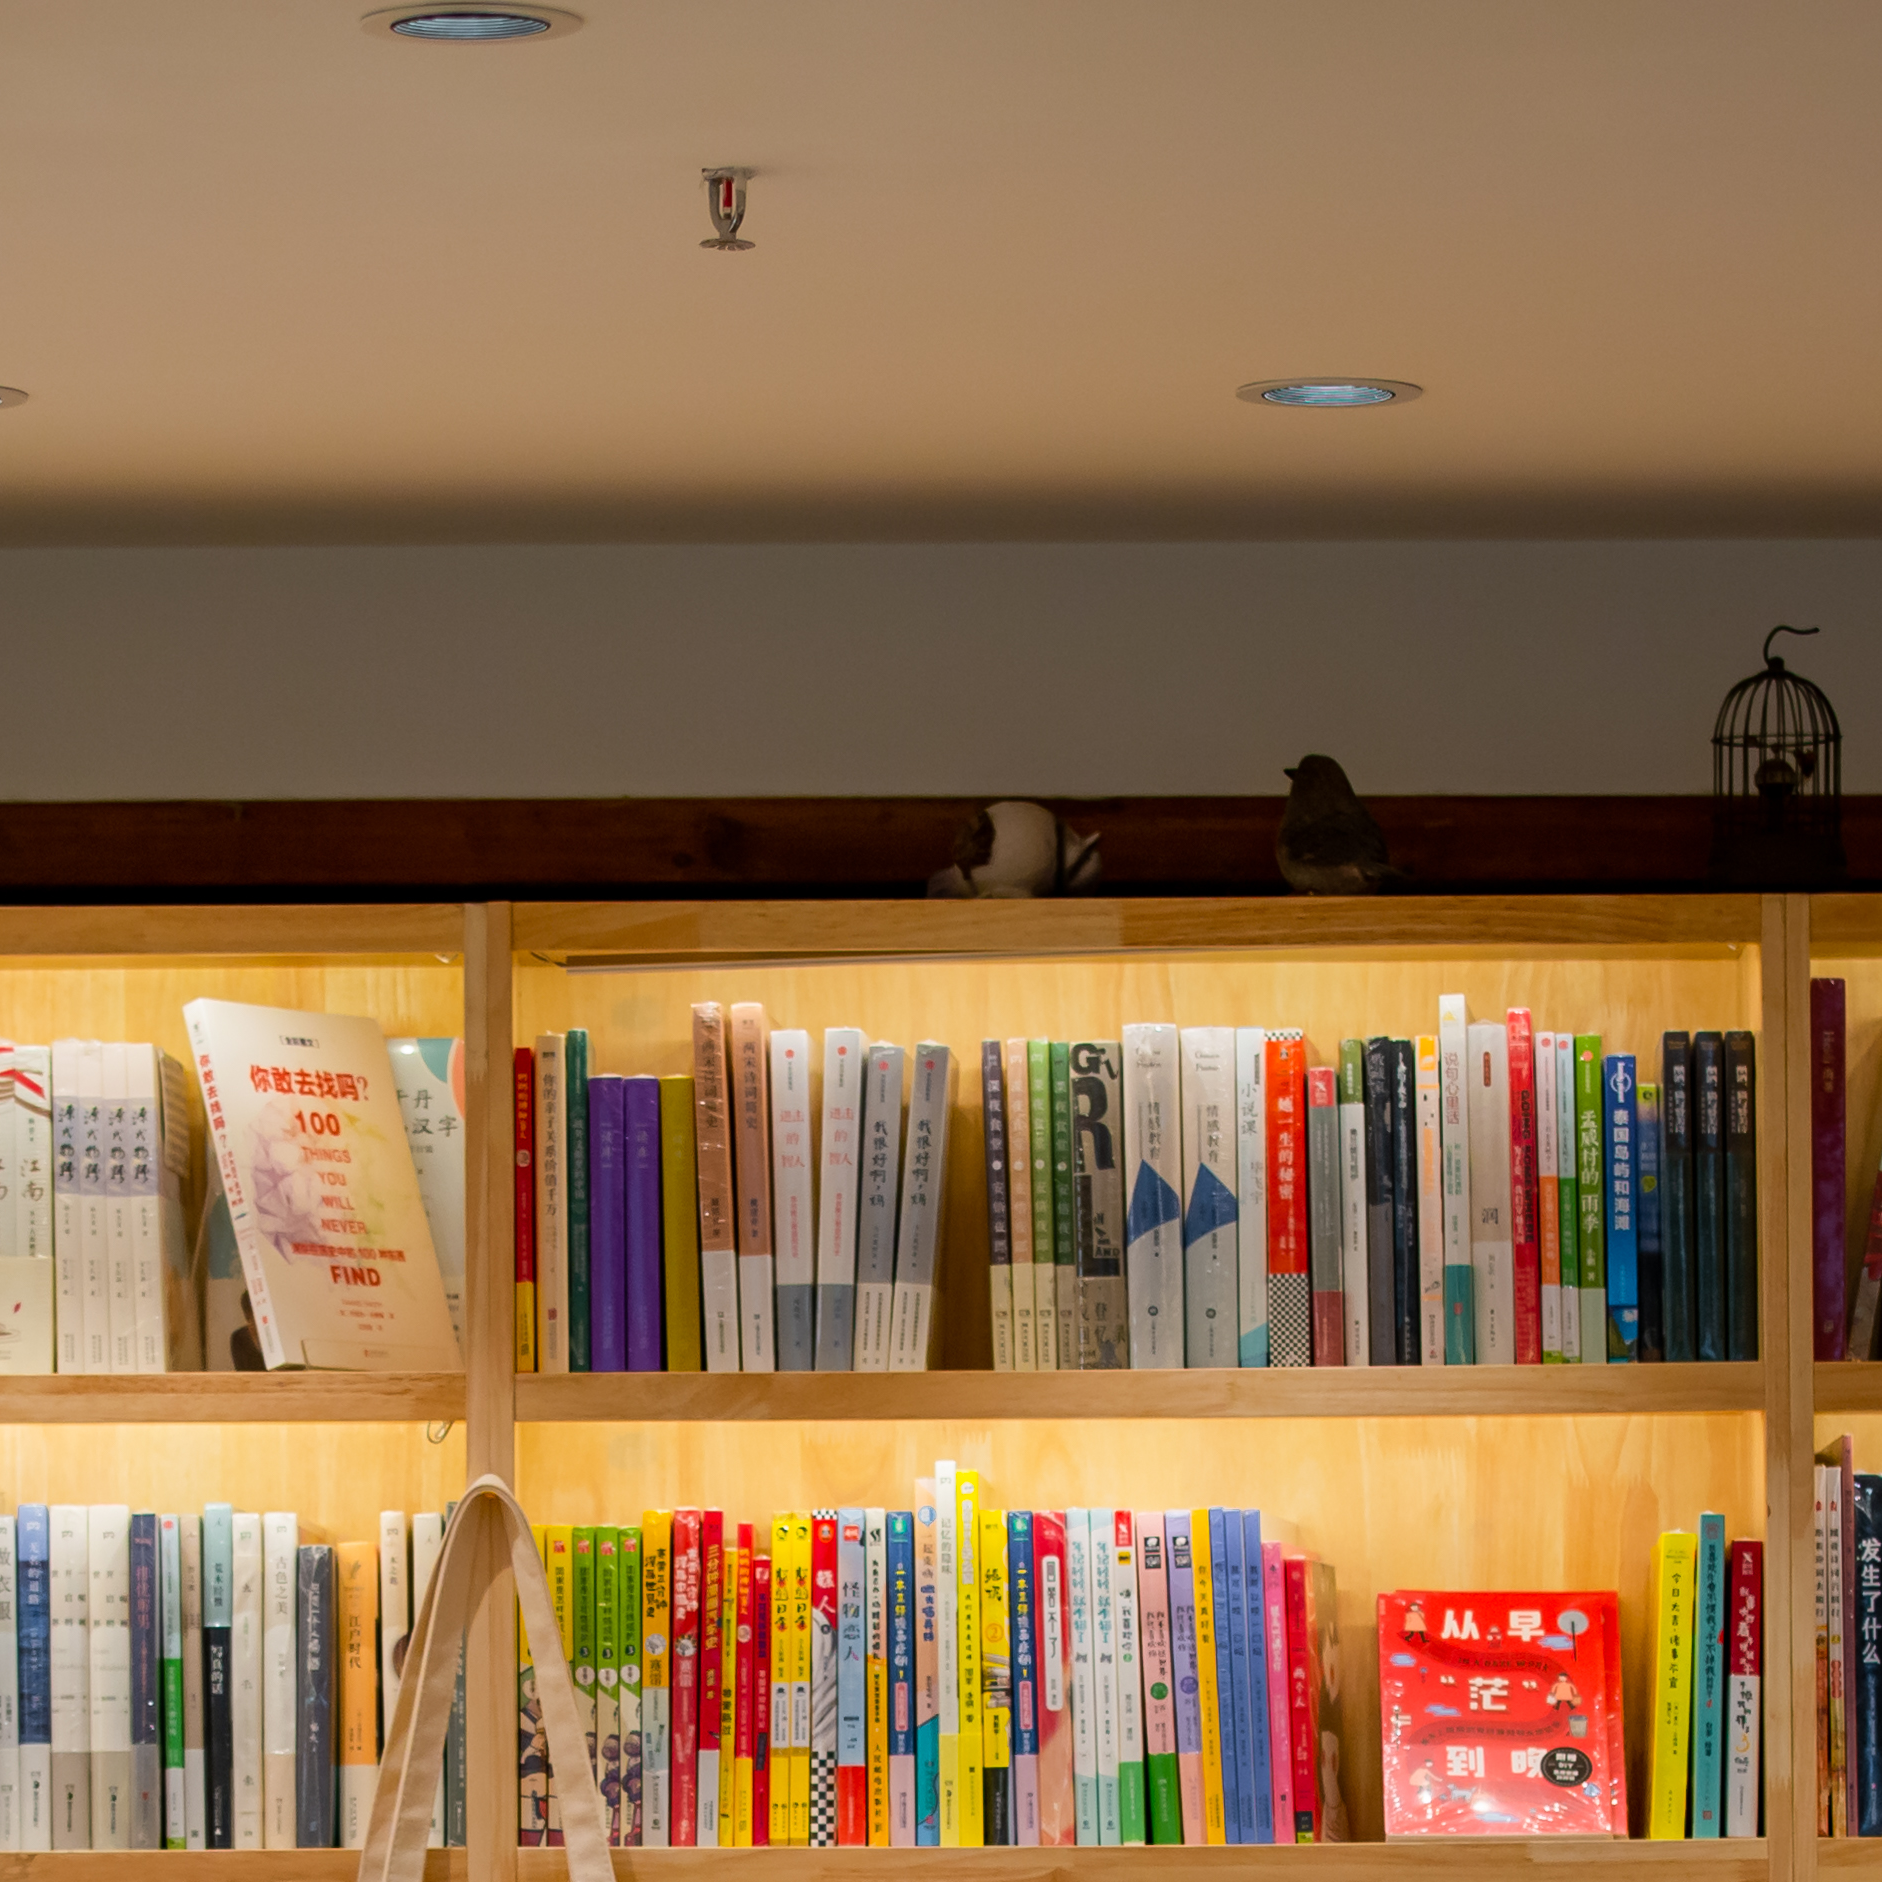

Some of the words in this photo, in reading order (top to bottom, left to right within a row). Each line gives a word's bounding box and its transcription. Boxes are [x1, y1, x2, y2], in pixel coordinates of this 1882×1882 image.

[294, 1110, 341, 1137] 100
[1520, 1089, 1532, 1139] GOING
[301, 1146, 352, 1165] THINGS
[318, 1172, 348, 1188] YOU
[321, 1194, 356, 1211] WILL
[321, 1218, 369, 1235] NEVER
[330, 1265, 382, 1287] FIND
[1860, 1536, 1882, 1667] 发生了什么
[842, 1581, 861, 1661] 怪物恋人
[1440, 1608, 1546, 1642] 从早
[346, 1614, 364, 1670] 江户时代
[1446, 1745, 1548, 1779] 到晚
[1558, 1761, 1574, 1769] DIY
